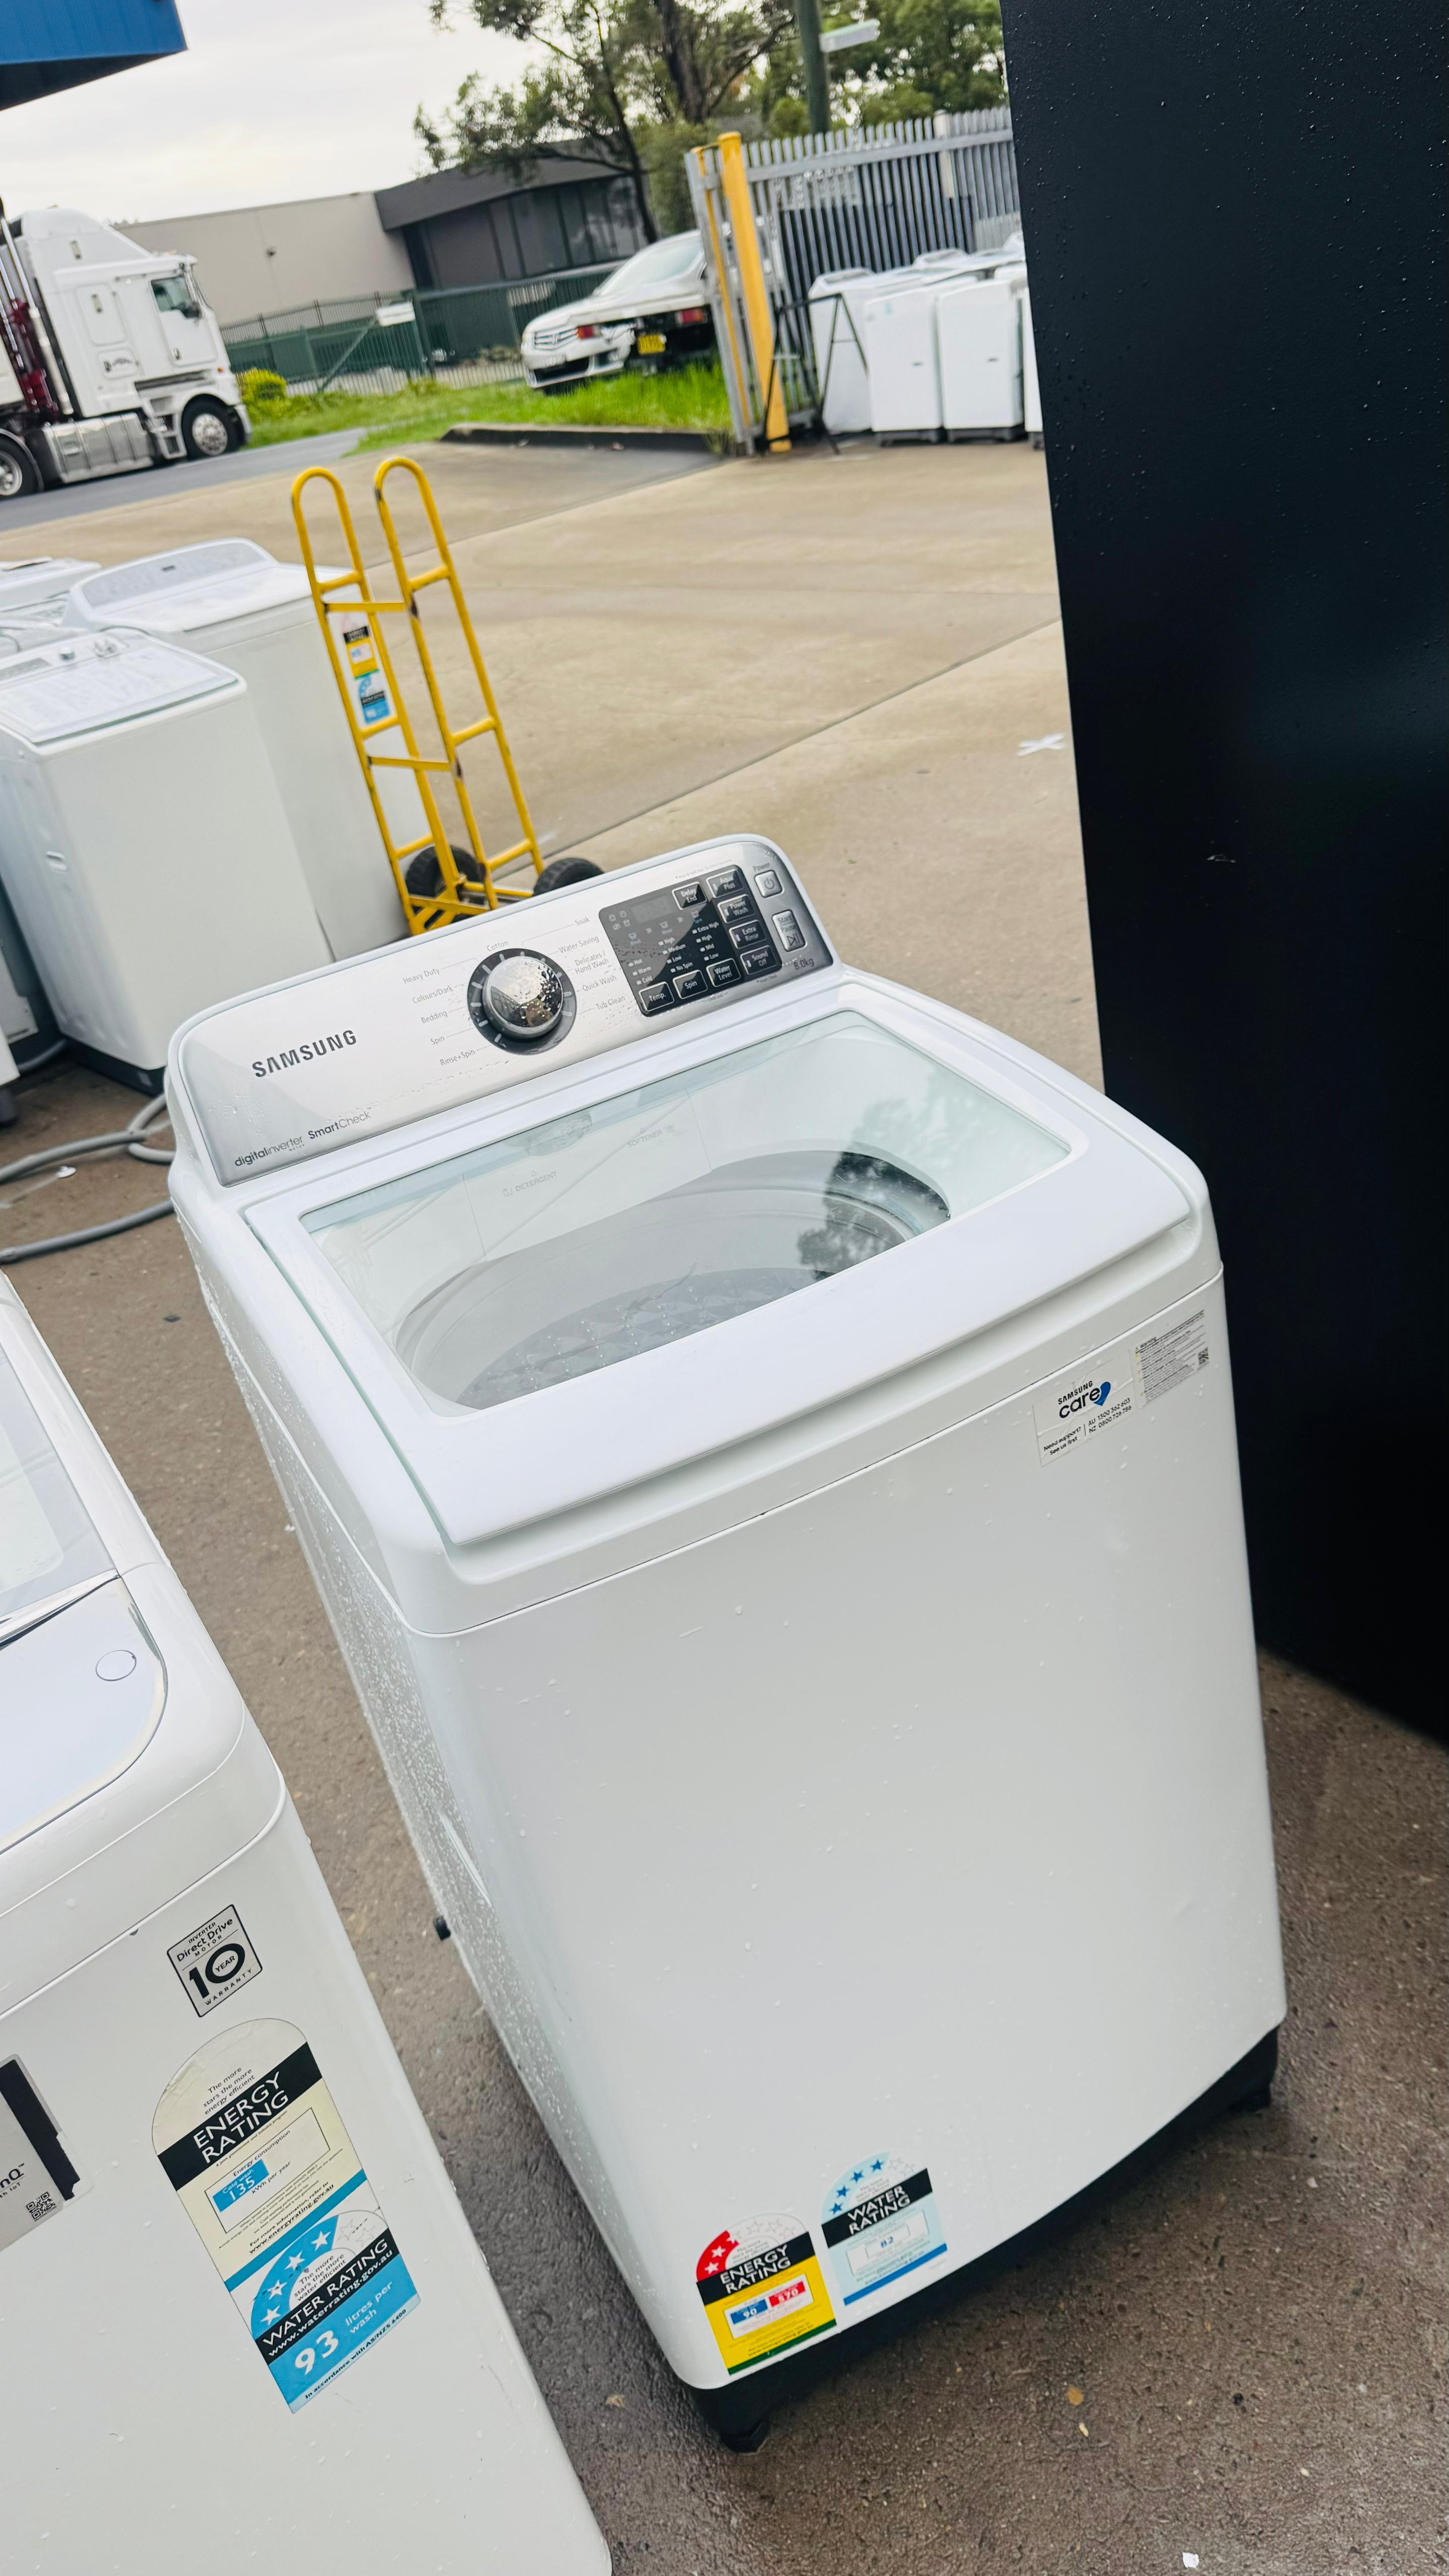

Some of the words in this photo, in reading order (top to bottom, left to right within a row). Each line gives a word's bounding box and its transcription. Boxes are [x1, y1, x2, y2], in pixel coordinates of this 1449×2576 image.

[753, 862, 771, 872] Power
[680, 888, 697, 898] Delay
[730, 900, 746, 910] Power
[733, 907, 749, 916] Wash
[575, 916, 590, 926] Soak
[777, 915, 792, 924] Start
[742, 926, 757, 935] Extra
[745, 933, 759, 941] Rinse
[487, 941, 509, 951] Cotton
[559, 942, 578, 953] Water
[579, 936, 600, 946] Saving
[575, 953, 602, 966] Delicates
[752, 951, 769, 961] Sound
[793, 958, 815, 970] 8.0kg
[403, 974, 423, 984] Heavy
[424, 968, 440, 978] Duty
[575, 964, 591, 975] Hand
[592, 958, 609, 968] Wash
[714, 965, 731, 974] Water
[718, 971, 733, 981] Level
[582, 981, 600, 992] Quick
[600, 975, 617, 985] Wash
[685, 981, 697, 990] Spin
[412, 986, 454, 1004] Colours/Dark
[596, 1001, 608, 1010] Tub
[608, 996, 626, 1006] Clean
[649, 993, 667, 1002] Temp.
[421, 1010, 448, 1023] Bedding
[430, 1035, 445, 1045] Spin
[252, 1030, 357, 1077] SAMSUNG
[440, 1049, 475, 1066] Rinse+Spin
[308, 1111, 371, 1139] SmartCheck
[627, 1129, 663, 1148] SOFTENER
[515, 1171, 557, 1192] DETERGENT
[1058, 1381, 1093, 1405] SAMSUNG
[1059, 1388, 1100, 1418] care
[1088, 1418, 1096, 1426] AU
[1097, 1410, 1110, 1420] 1300
[1098, 1417, 1112, 1428] 0800
[1043, 1439, 1058, 1451] Need
[1059, 1427, 1081, 1443] support?
[1050, 1446, 1060, 1455] See
[1068, 1436, 1077, 1444] first
[177, 1938, 207, 1962] Direct
[207, 1918, 233, 1940] Drive
[189, 1921, 216, 1944] INVERTER
[195, 1935, 222, 1957] MOTOR
[189, 1943, 245, 1999] 10
[215, 1955, 235, 1972] YEAR
[205, 1968, 252, 2005] WARRANTY
[203, 2094, 220, 2108] stars
[221, 2083, 232, 2095] the
[234, 2069, 252, 2084] more
[208, 2081, 222, 2094] The
[223, 2067, 242, 2083] more
[205, 2096, 227, 2115] energy
[229, 2075, 255, 2097] efficient
[193, 2071, 279, 2149] ENERGY
[202, 2090, 289, 2163] RATING
[233, 2159, 253, 2177] Energy
[254, 2130, 290, 2160] consumption
[222, 2180, 237, 2194] Cold
[252, 2180, 267, 2194] kWh
[268, 2172, 278, 2184] per
[278, 2161, 291, 2175] year
[228, 2176, 255, 2201] 135
[847, 2185, 905, 2221] WATER
[849, 2194, 911, 2235] RATING
[299, 2272, 314, 2284] The
[315, 2255, 334, 2273] more
[720, 2244, 787, 2285] ENERGY
[294, 2282, 312, 2297] stars
[312, 2271, 325, 2283] the
[326, 2254, 345, 2271] more
[297, 2284, 317, 2302] water
[319, 2260, 347, 2282] efficient
[725, 2257, 791, 2294] RATING
[263, 2296, 325, 2346] WATER
[327, 2239, 388, 2297] RATING
[269, 2249, 393, 2357] www.waterrating.gov.au
[294, 2330, 339, 2375] 93
[345, 2300, 373, 2326] litres
[375, 2282, 393, 2302] per
[350, 2309, 377, 2334] wash
[313, 2360, 350, 2393] accordance
[351, 2345, 366, 2360] with
[366, 2323, 390, 2348] AS/NZS
